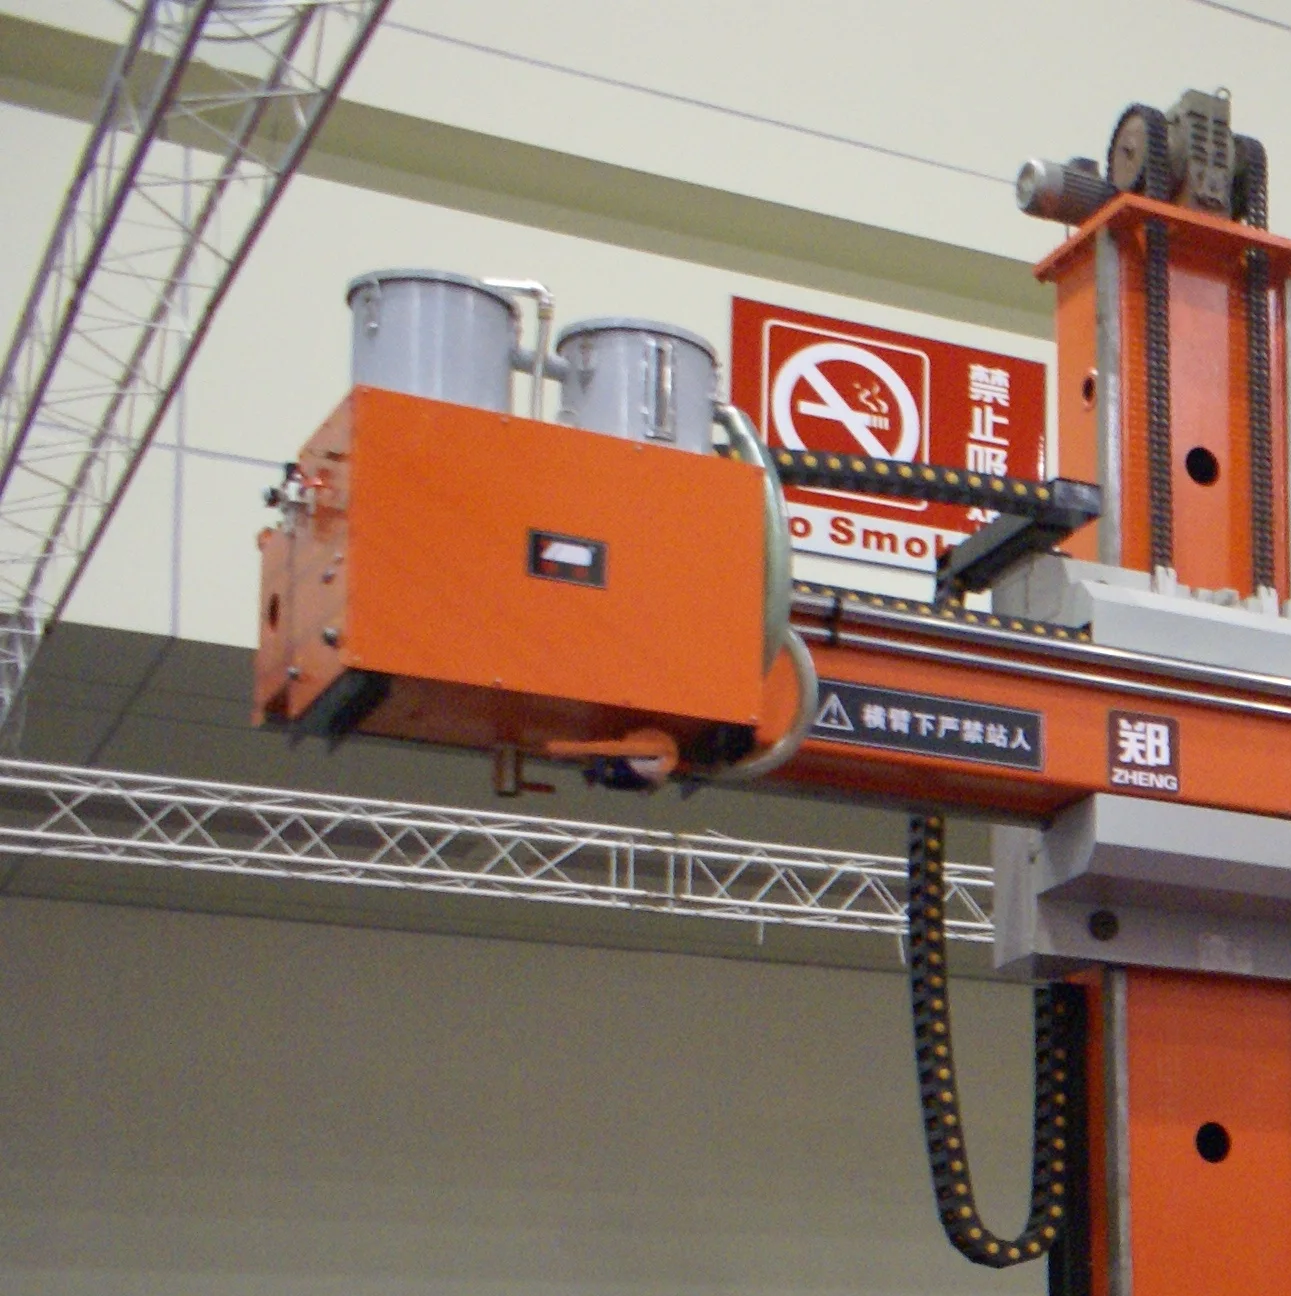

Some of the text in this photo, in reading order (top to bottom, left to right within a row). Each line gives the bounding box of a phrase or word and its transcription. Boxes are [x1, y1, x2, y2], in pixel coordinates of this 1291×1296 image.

[788, 516, 812, 538] o
[1118, 718, 1171, 766] 郑
[1112, 769, 1178, 791] ZHENG
